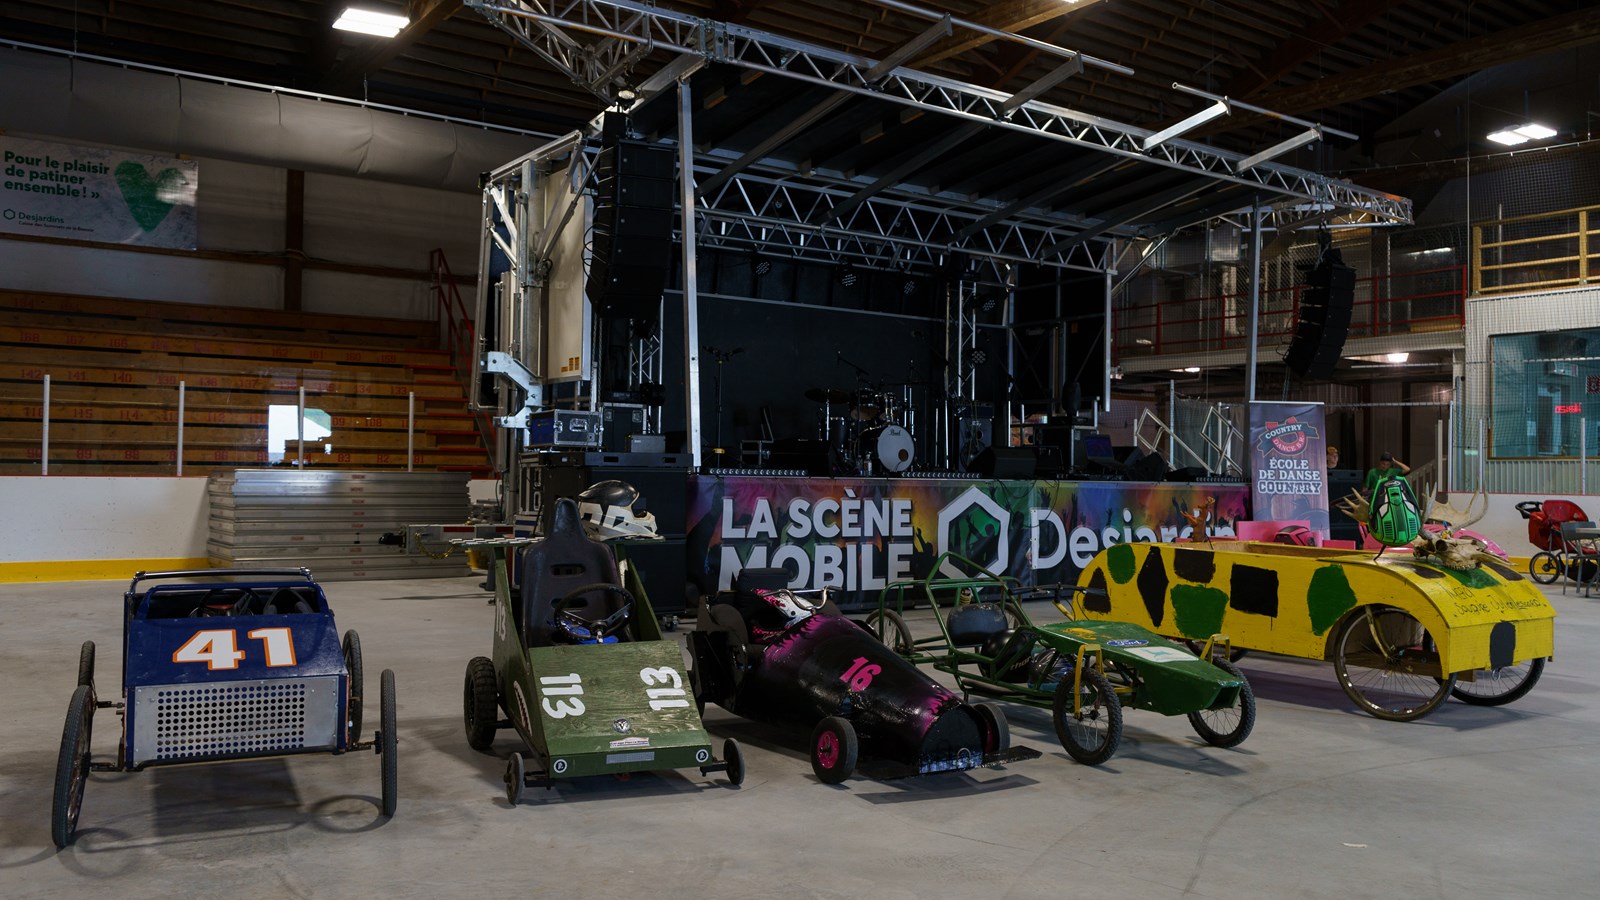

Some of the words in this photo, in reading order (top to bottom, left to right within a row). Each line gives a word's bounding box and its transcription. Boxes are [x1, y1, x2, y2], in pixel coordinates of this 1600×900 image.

[4, 151, 42, 166] Pour
[45, 156, 60, 168] le
[63, 160, 110, 174] plaisir
[5, 166, 25, 178] de
[29, 169, 85, 185] patiner
[18, 212, 64, 223] Desjardins
[20, 369, 42, 379] 142
[67, 371, 87, 381] 141
[112, 372, 132, 383] 140
[73, 408, 93, 418] 115
[119, 410, 140, 420] 114
[1265, 424, 1302, 439] COUNTRY
[1273, 439, 1297, 452] DANCE
[1269, 457, 1309, 469] ÉCOLE
[1259, 470, 1275, 480] DE
[1280, 470, 1320, 480] DANSE
[1258, 481, 1322, 494] COUNTRY
[721, 497, 778, 539] LA
[788, 487, 912, 539] SCÈNE
[718, 544, 914, 592] MOBILE
[172, 627, 297, 671] 41
[839, 656, 883, 692] 16
[540, 673, 586, 719] 113
[640, 666, 690, 711] 113
